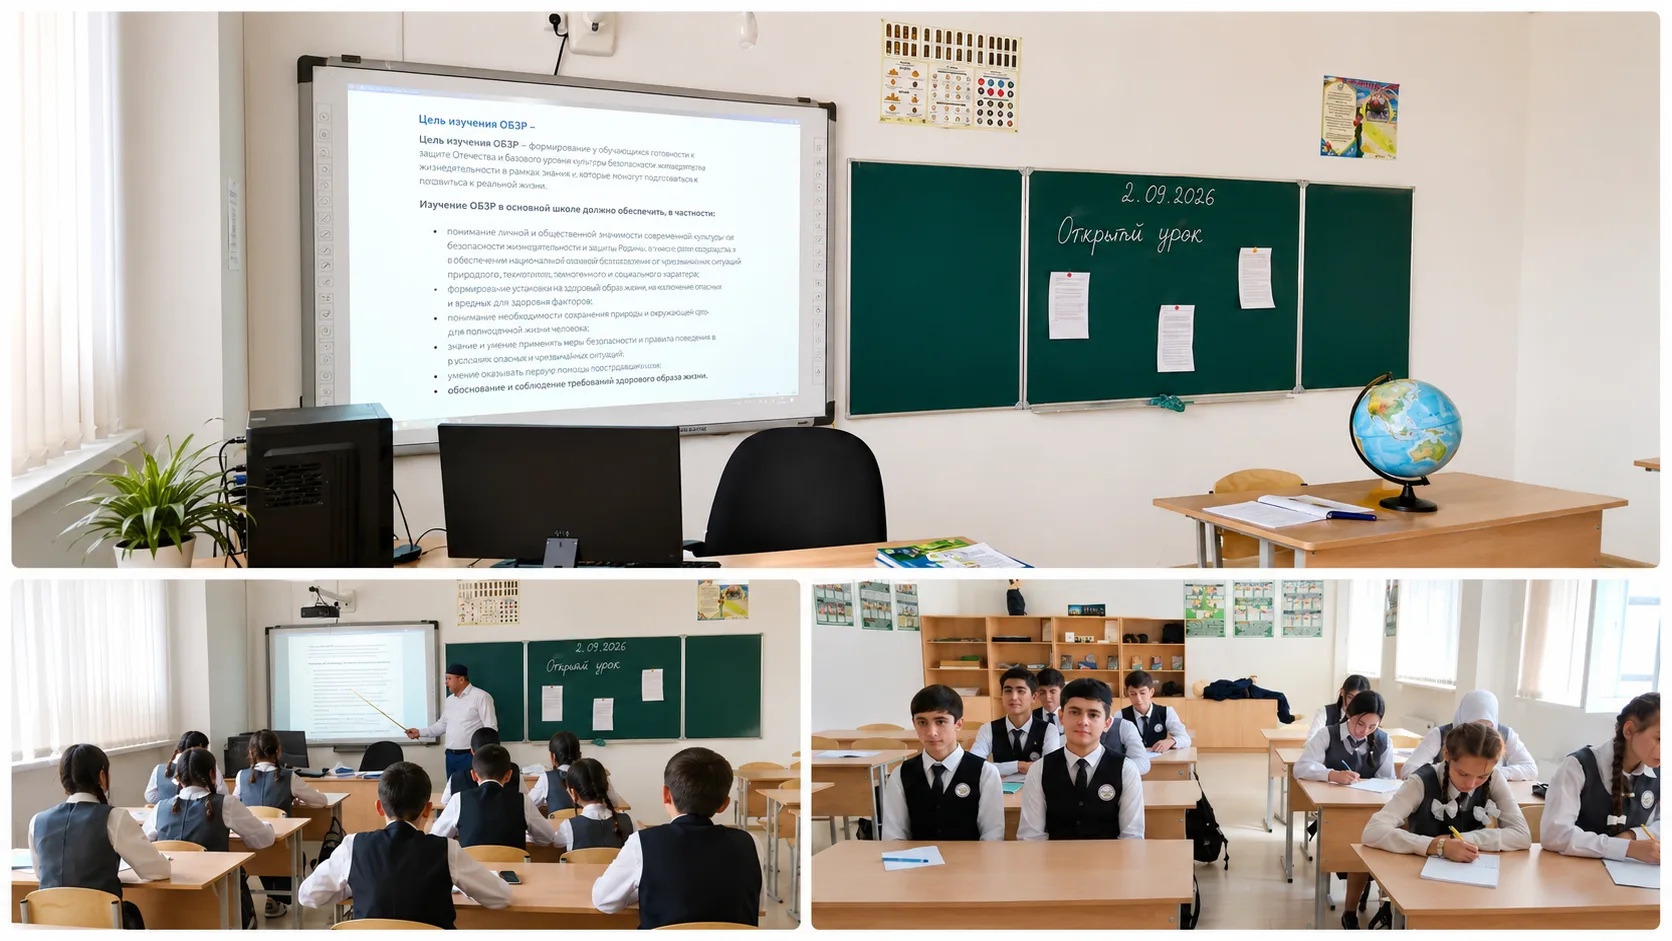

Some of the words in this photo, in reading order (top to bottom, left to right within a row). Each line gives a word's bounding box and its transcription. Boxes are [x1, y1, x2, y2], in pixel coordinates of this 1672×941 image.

[419, 115, 446, 125] Цель
[449, 118, 497, 129] изучения
[499, 120, 527, 130] ОБЗР
[419, 135, 444, 145] Цель
[447, 137, 491, 148] изучения
[493, 140, 519, 149] ОБЗР
[529, 142, 591, 153] формирование
[592, 147, 597, 155] у
[419, 149, 451, 159] защите
[452, 151, 496, 162] Отечества
[505, 155, 541, 164] базового
[1121, 181, 1216, 206] 2.09.2026
[420, 200, 467, 210] Изучение
[469, 201, 496, 210] ОБЗР
[506, 204, 550, 212] основной
[582, 206, 616, 215] должно
[618, 207, 667, 216] обеспечить,
[447, 228, 496, 236] понимание
[498, 228, 529, 237] личной
[538, 228, 597, 238] общественной
[1156, 228, 1204, 254] урок
[455, 300, 491, 308] вредных
[447, 384, 506, 394] обоснование
[514, 381, 566, 391] соблюдение
[575, 641, 627, 653] 2.09.2026
[595, 661, 621, 676] урок
